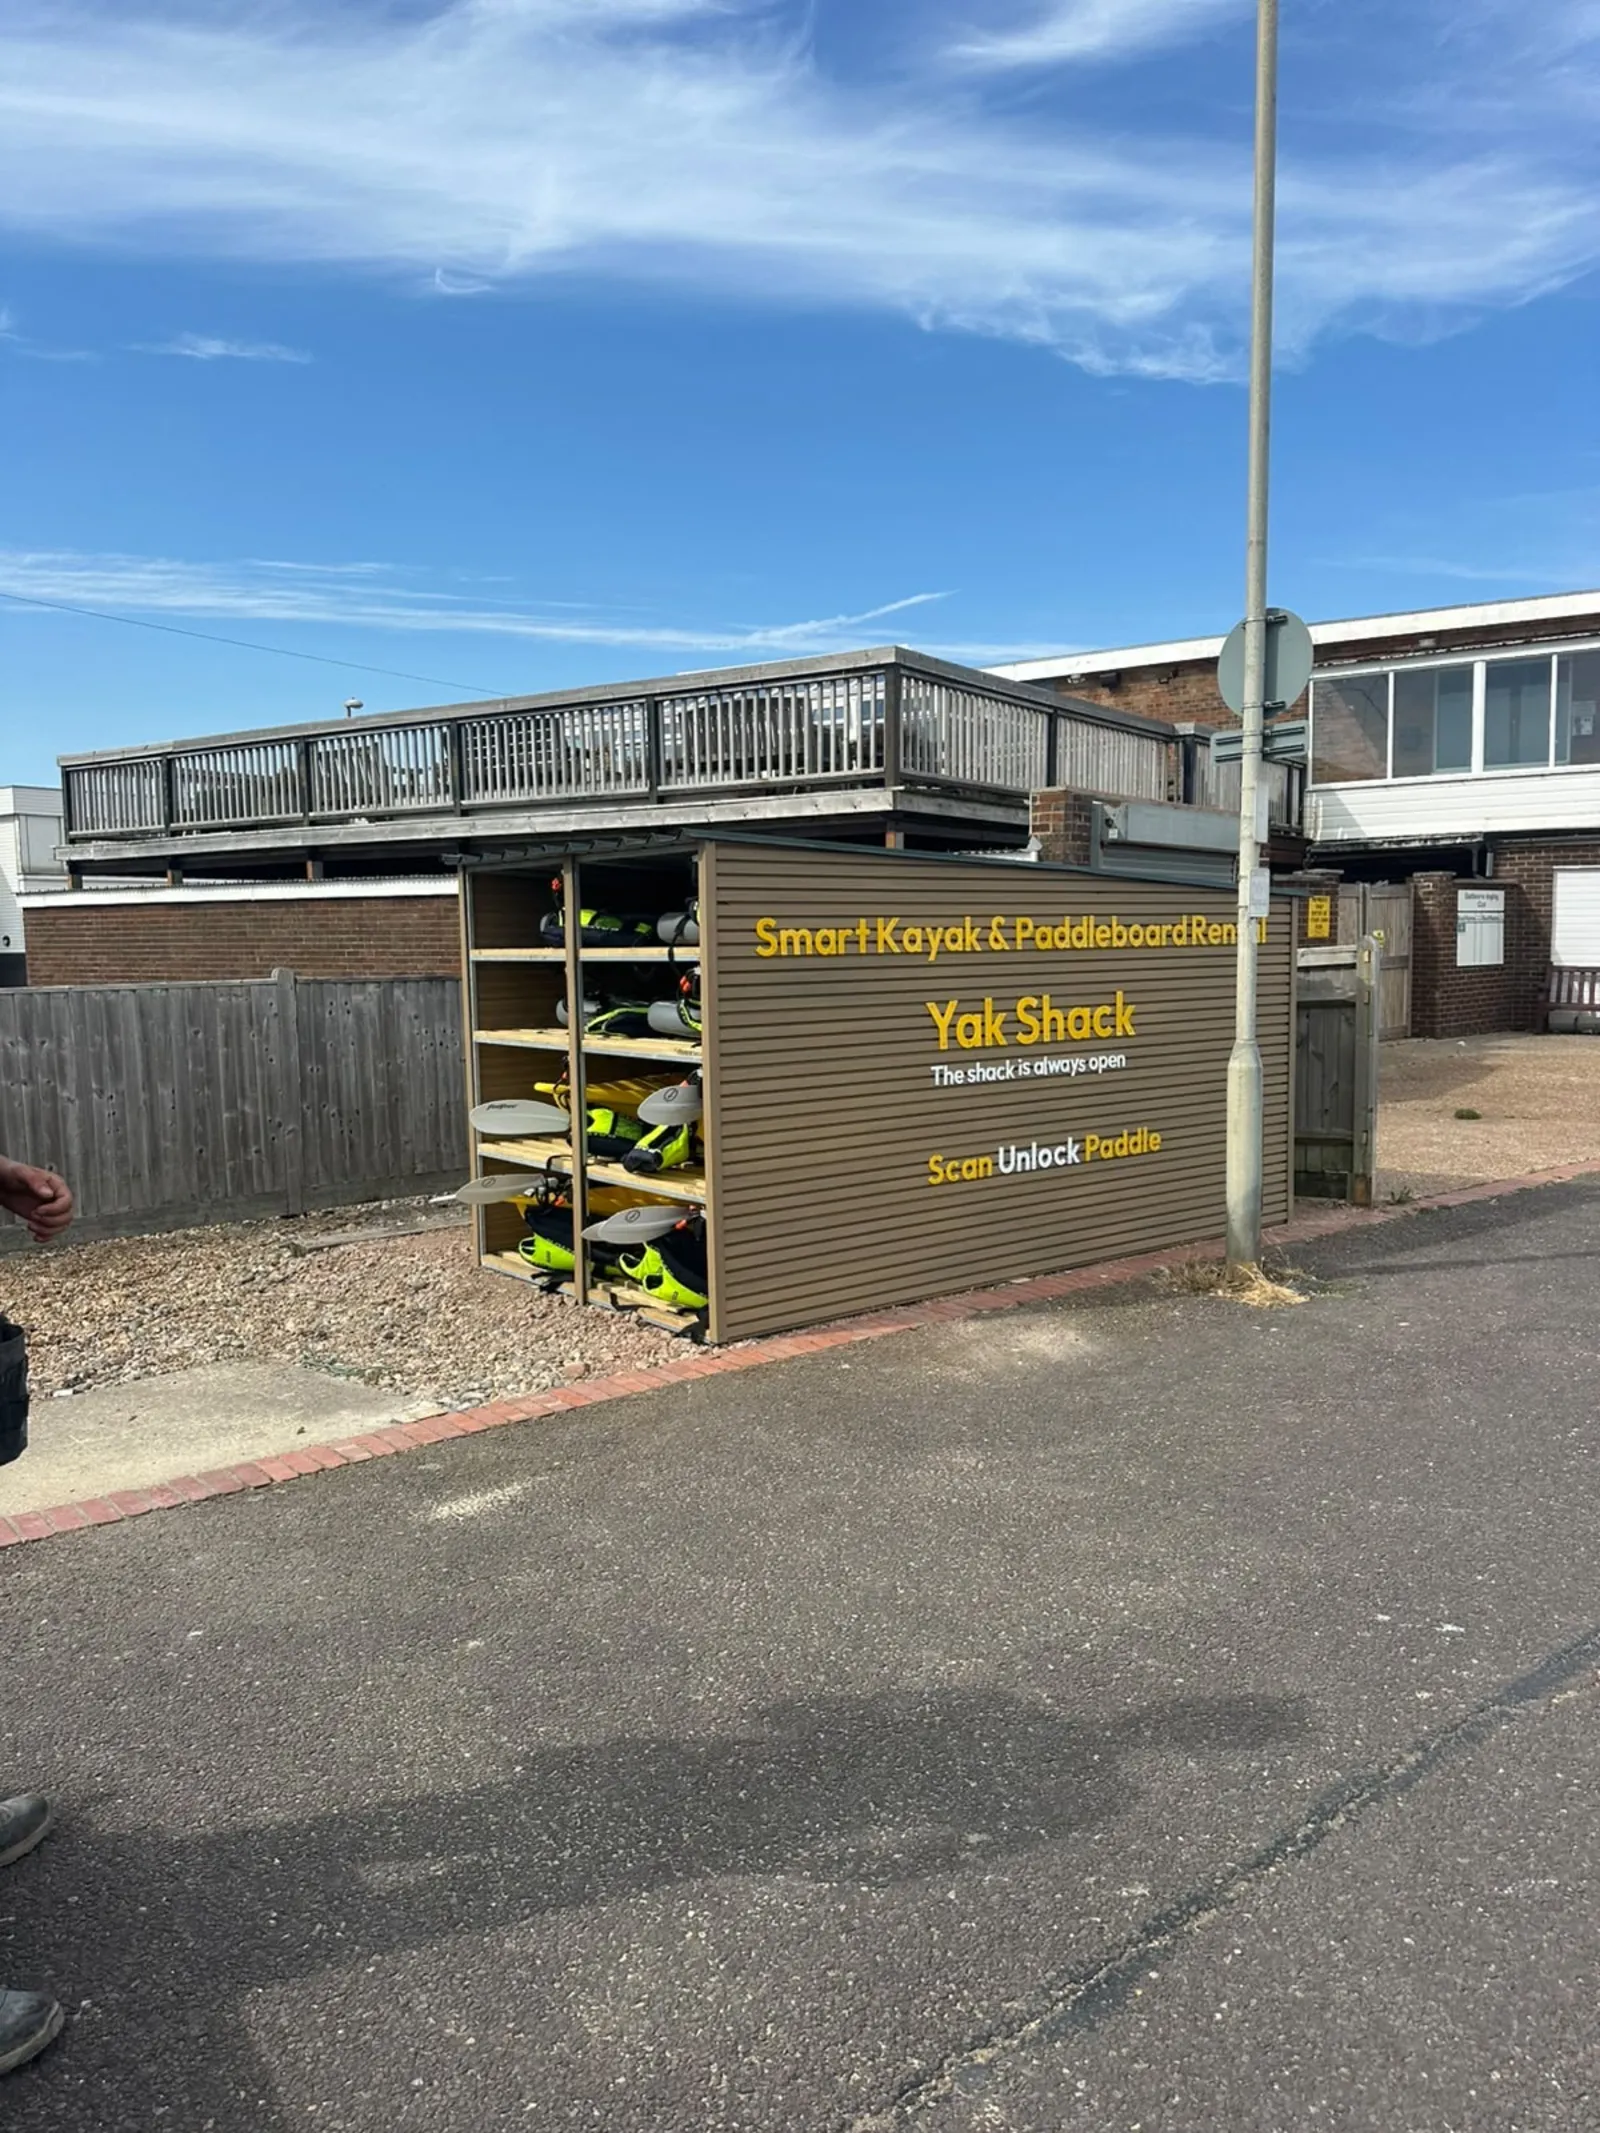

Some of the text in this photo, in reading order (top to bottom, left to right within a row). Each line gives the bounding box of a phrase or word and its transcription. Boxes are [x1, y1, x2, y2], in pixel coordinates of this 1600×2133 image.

[754, 914, 1267, 962] Smart Kayak & Paddleboard Renl
[925, 989, 1137, 1051] Yak Shack
[930, 1053, 1126, 1086] The shack is always open
[927, 1127, 1162, 1185] Scan Unlock Paddle
